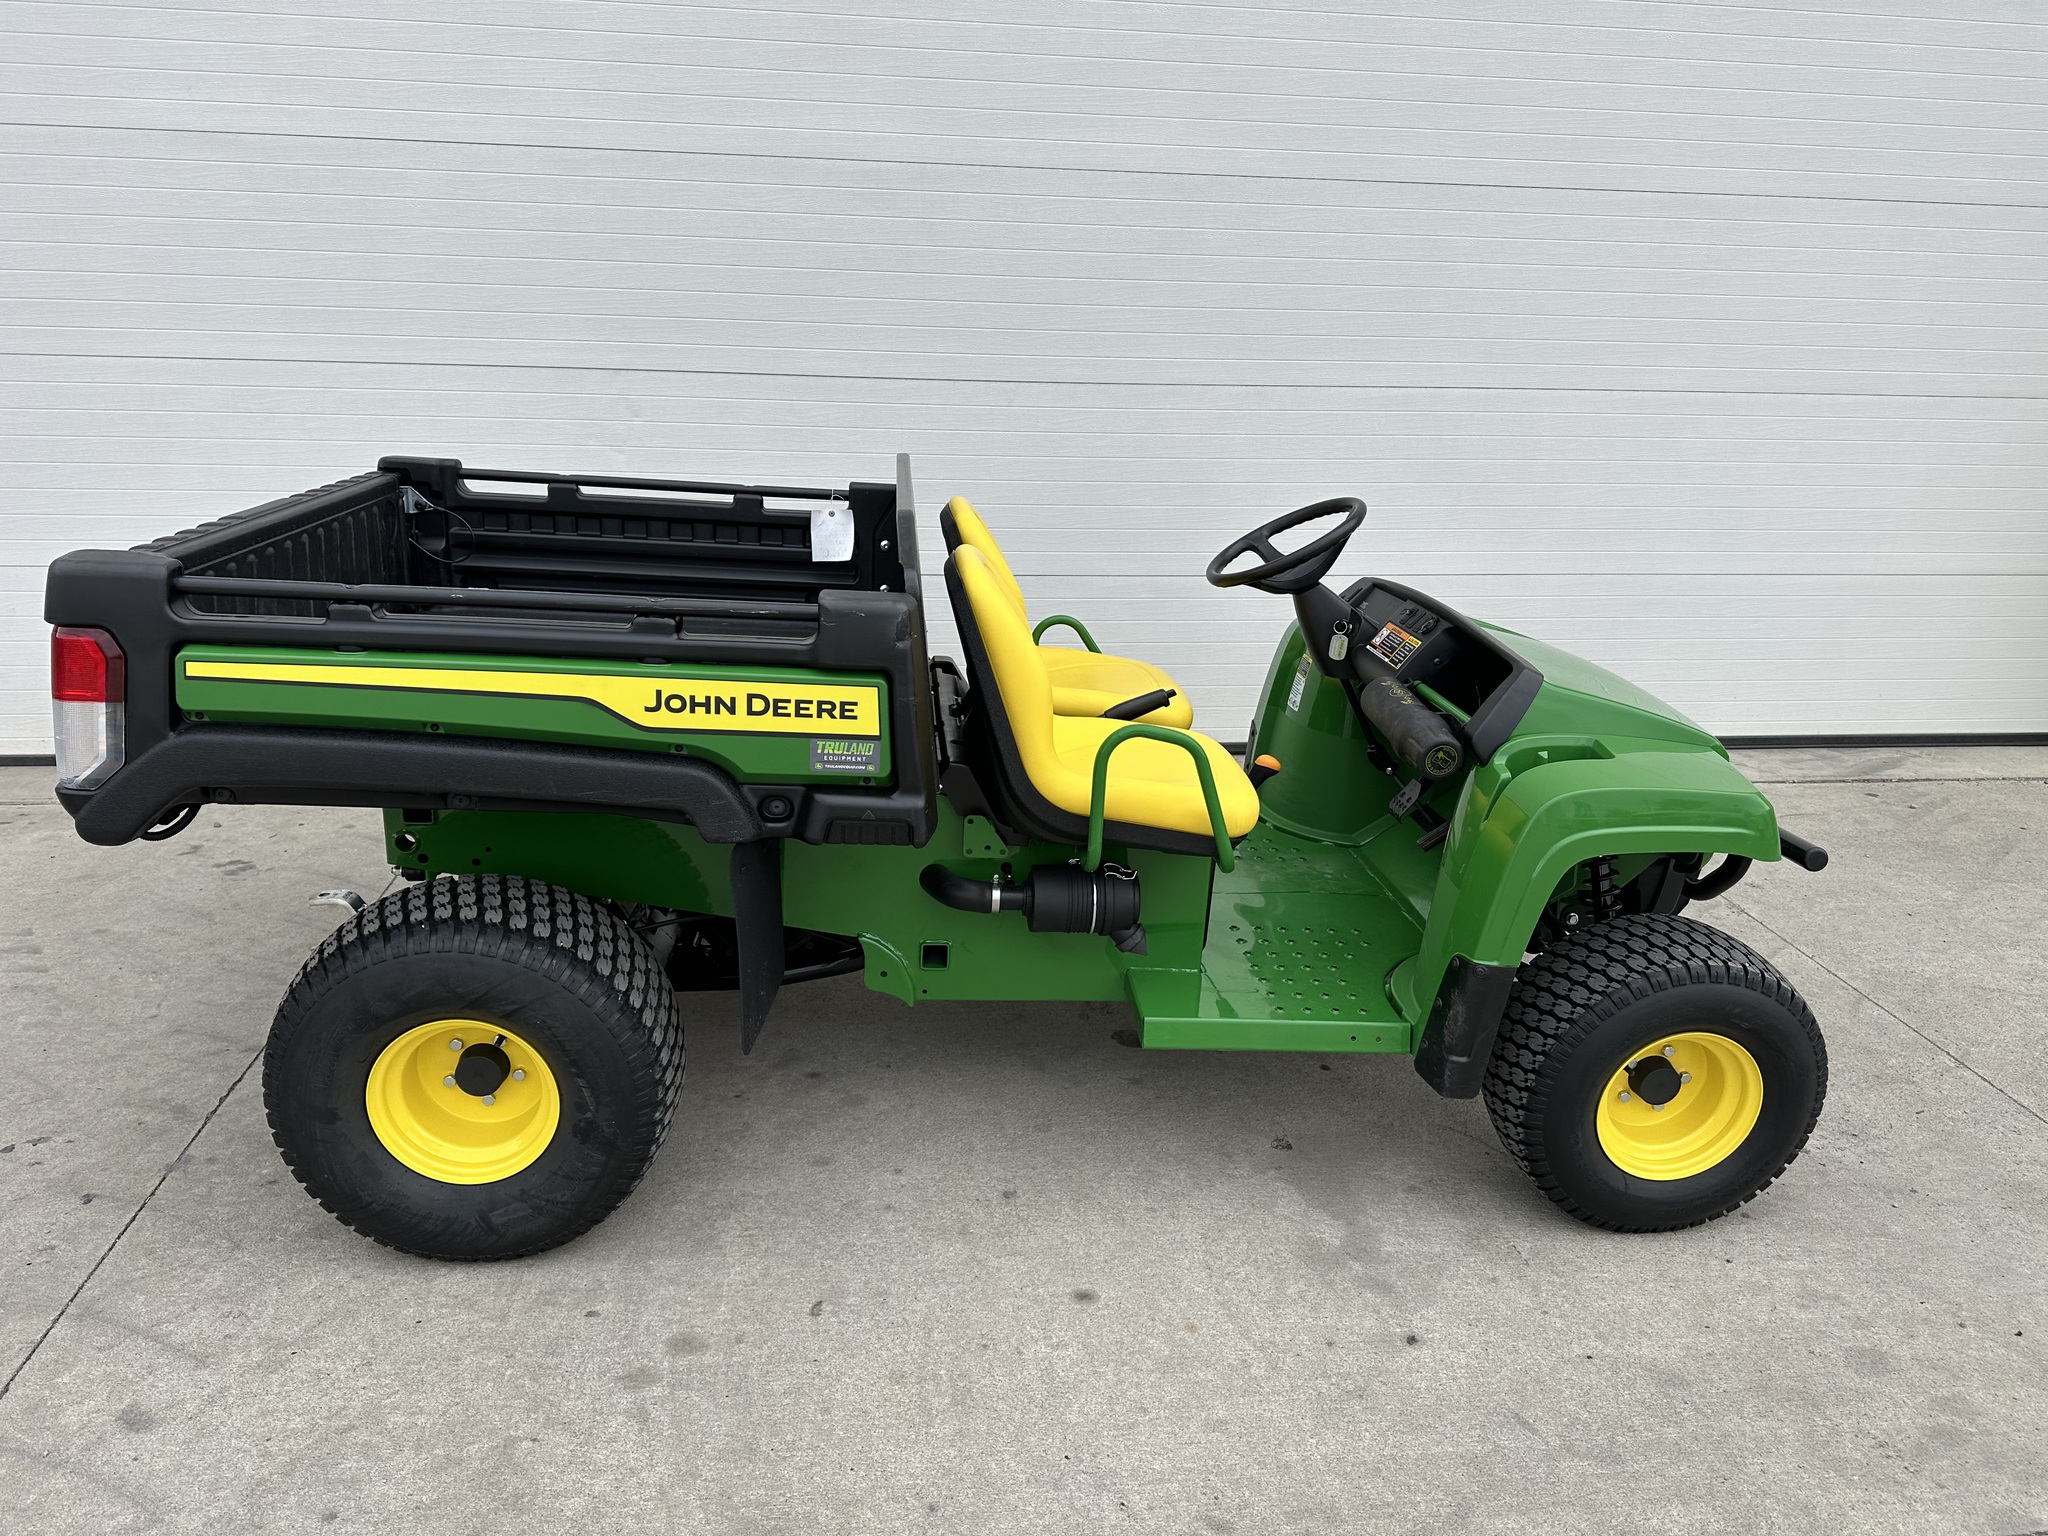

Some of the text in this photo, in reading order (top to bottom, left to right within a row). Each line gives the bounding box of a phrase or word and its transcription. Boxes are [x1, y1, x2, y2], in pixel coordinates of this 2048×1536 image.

[644, 689, 858, 720] JOHN DEERE
[816, 741, 874, 755] TRULAND
